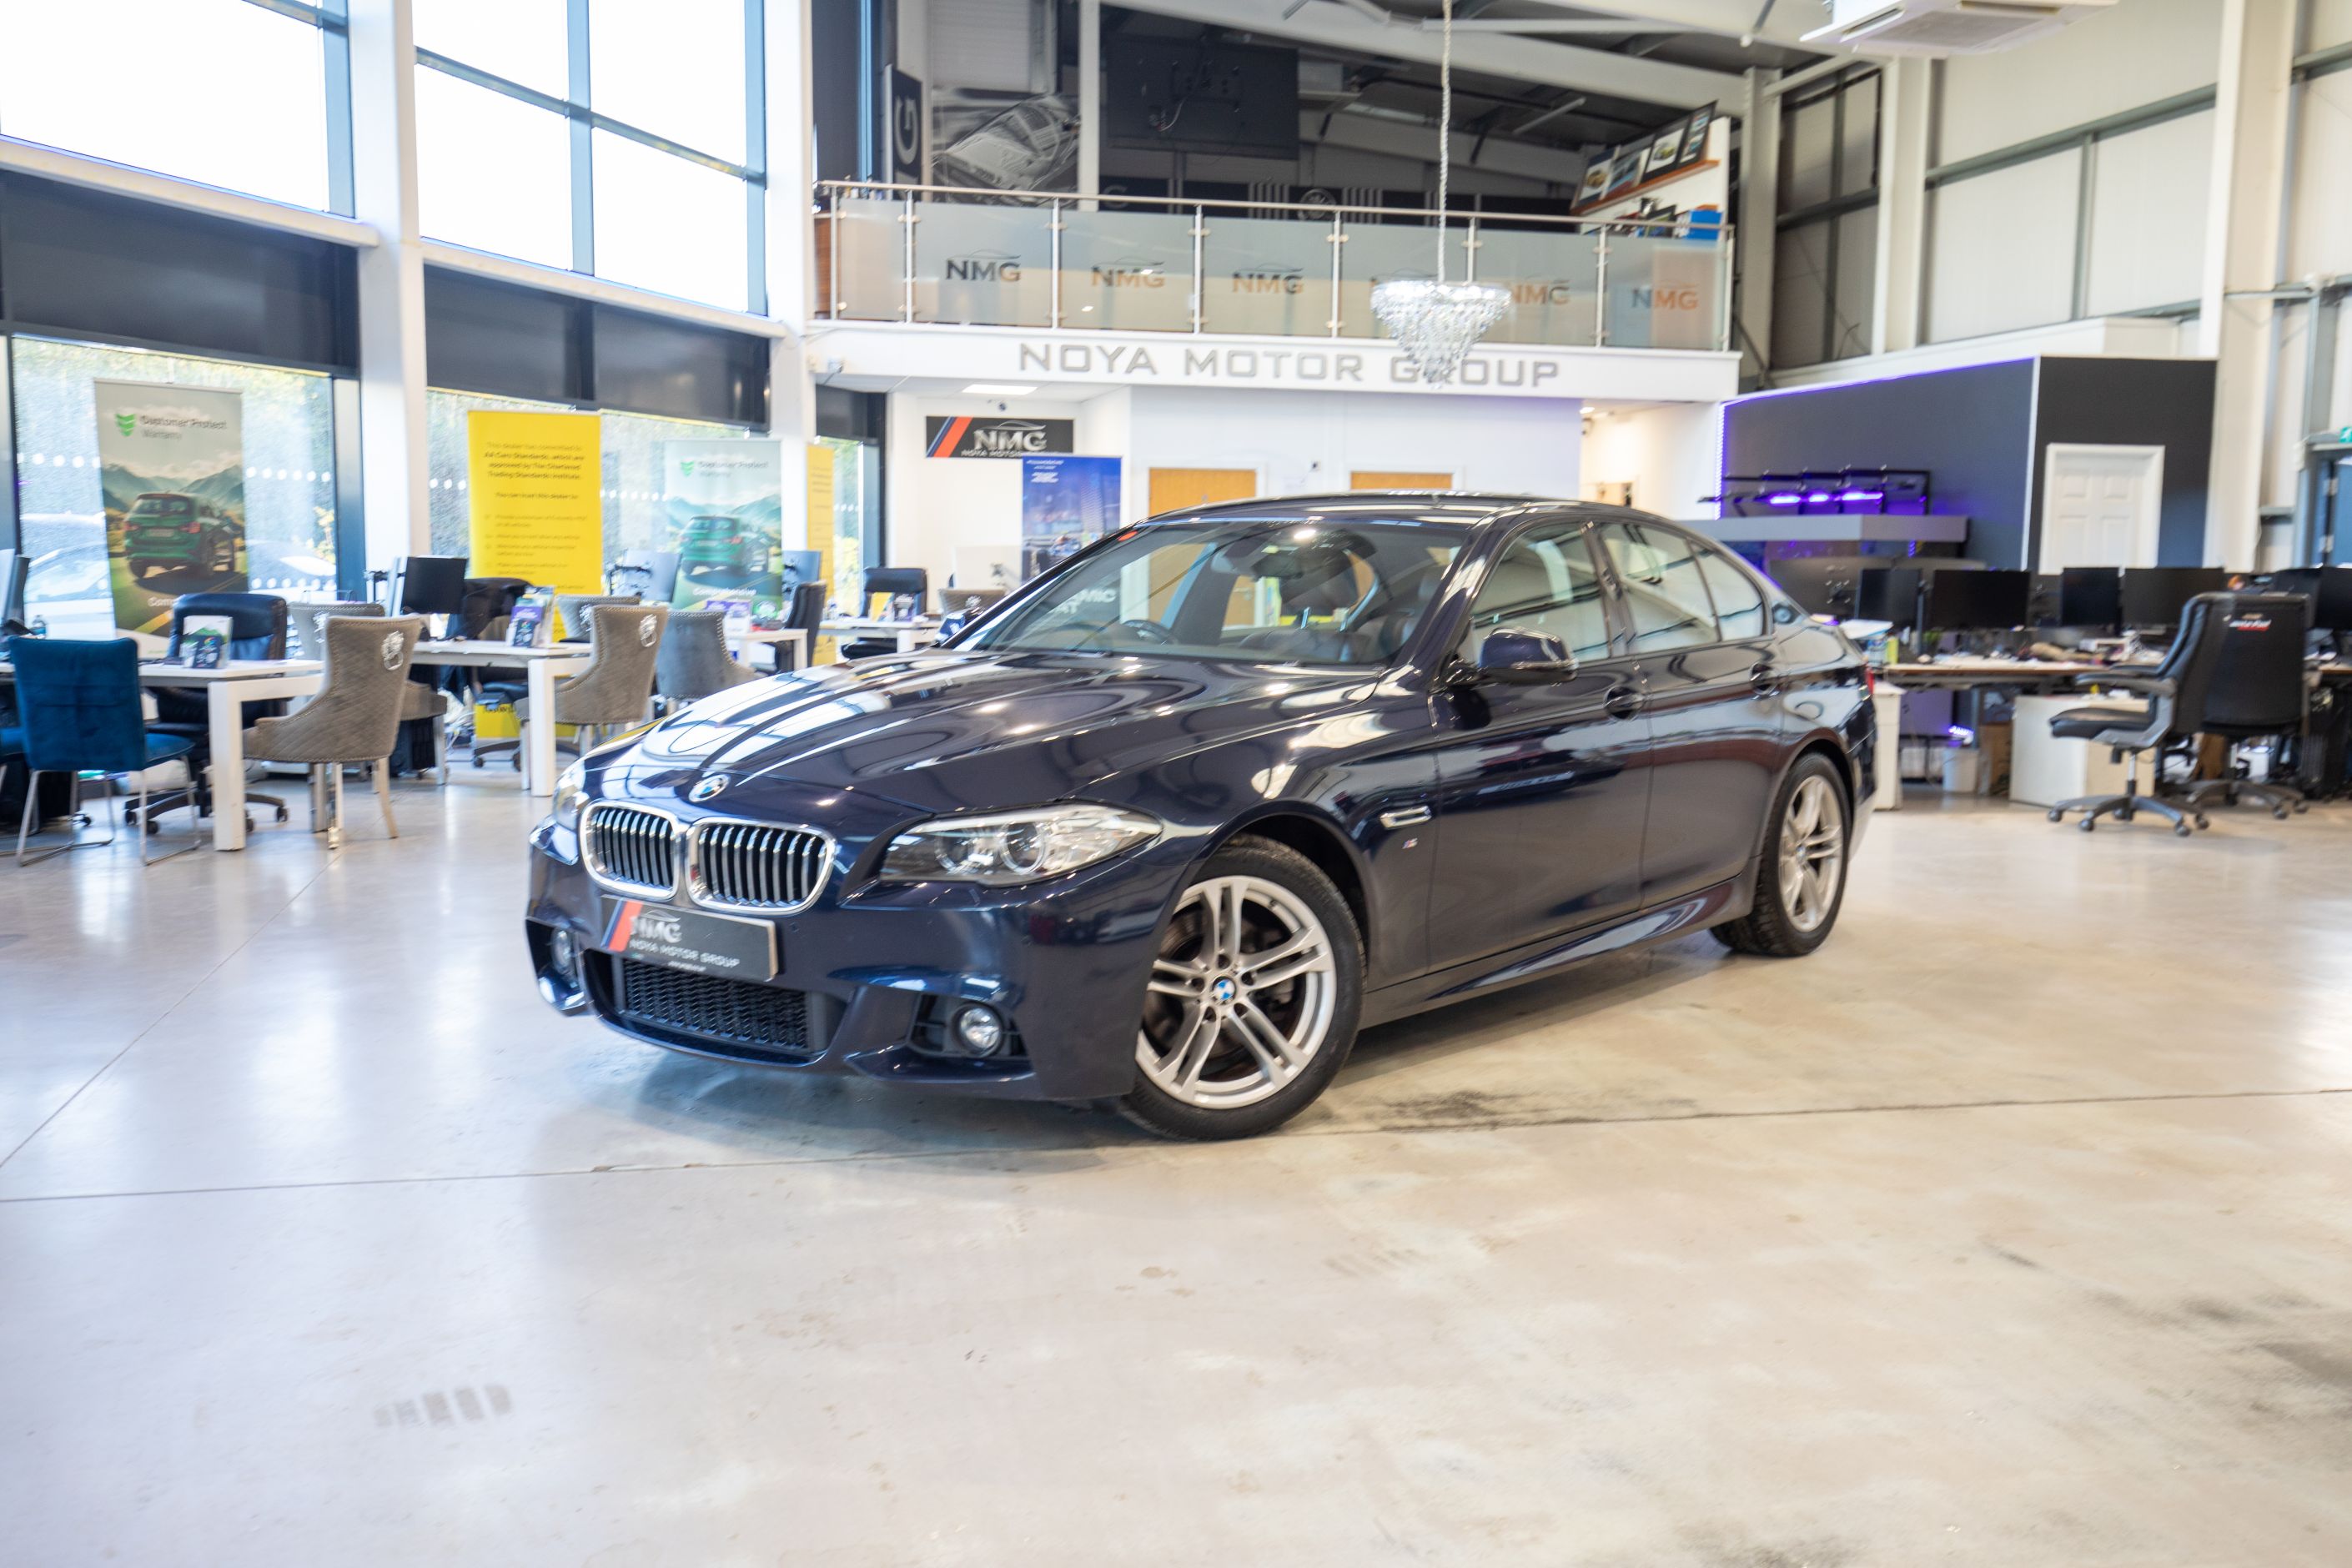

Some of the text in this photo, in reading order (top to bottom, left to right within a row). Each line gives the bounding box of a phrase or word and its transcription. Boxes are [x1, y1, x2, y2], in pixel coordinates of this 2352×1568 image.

[946, 259, 1021, 282] NMG
[1090, 266, 1165, 289] NMG
[1232, 273, 1304, 294] NMG
[1631, 288, 1699, 311] NMG
[1019, 343, 1559, 387] NOYA MOTOR GOUP
[973, 430, 1048, 451] NMG
[630, 917, 682, 943] NMG
[629, 937, 660, 953] NOYA
[659, 942, 700, 962] MOTOR
[700, 952, 741, 969] GROUP
